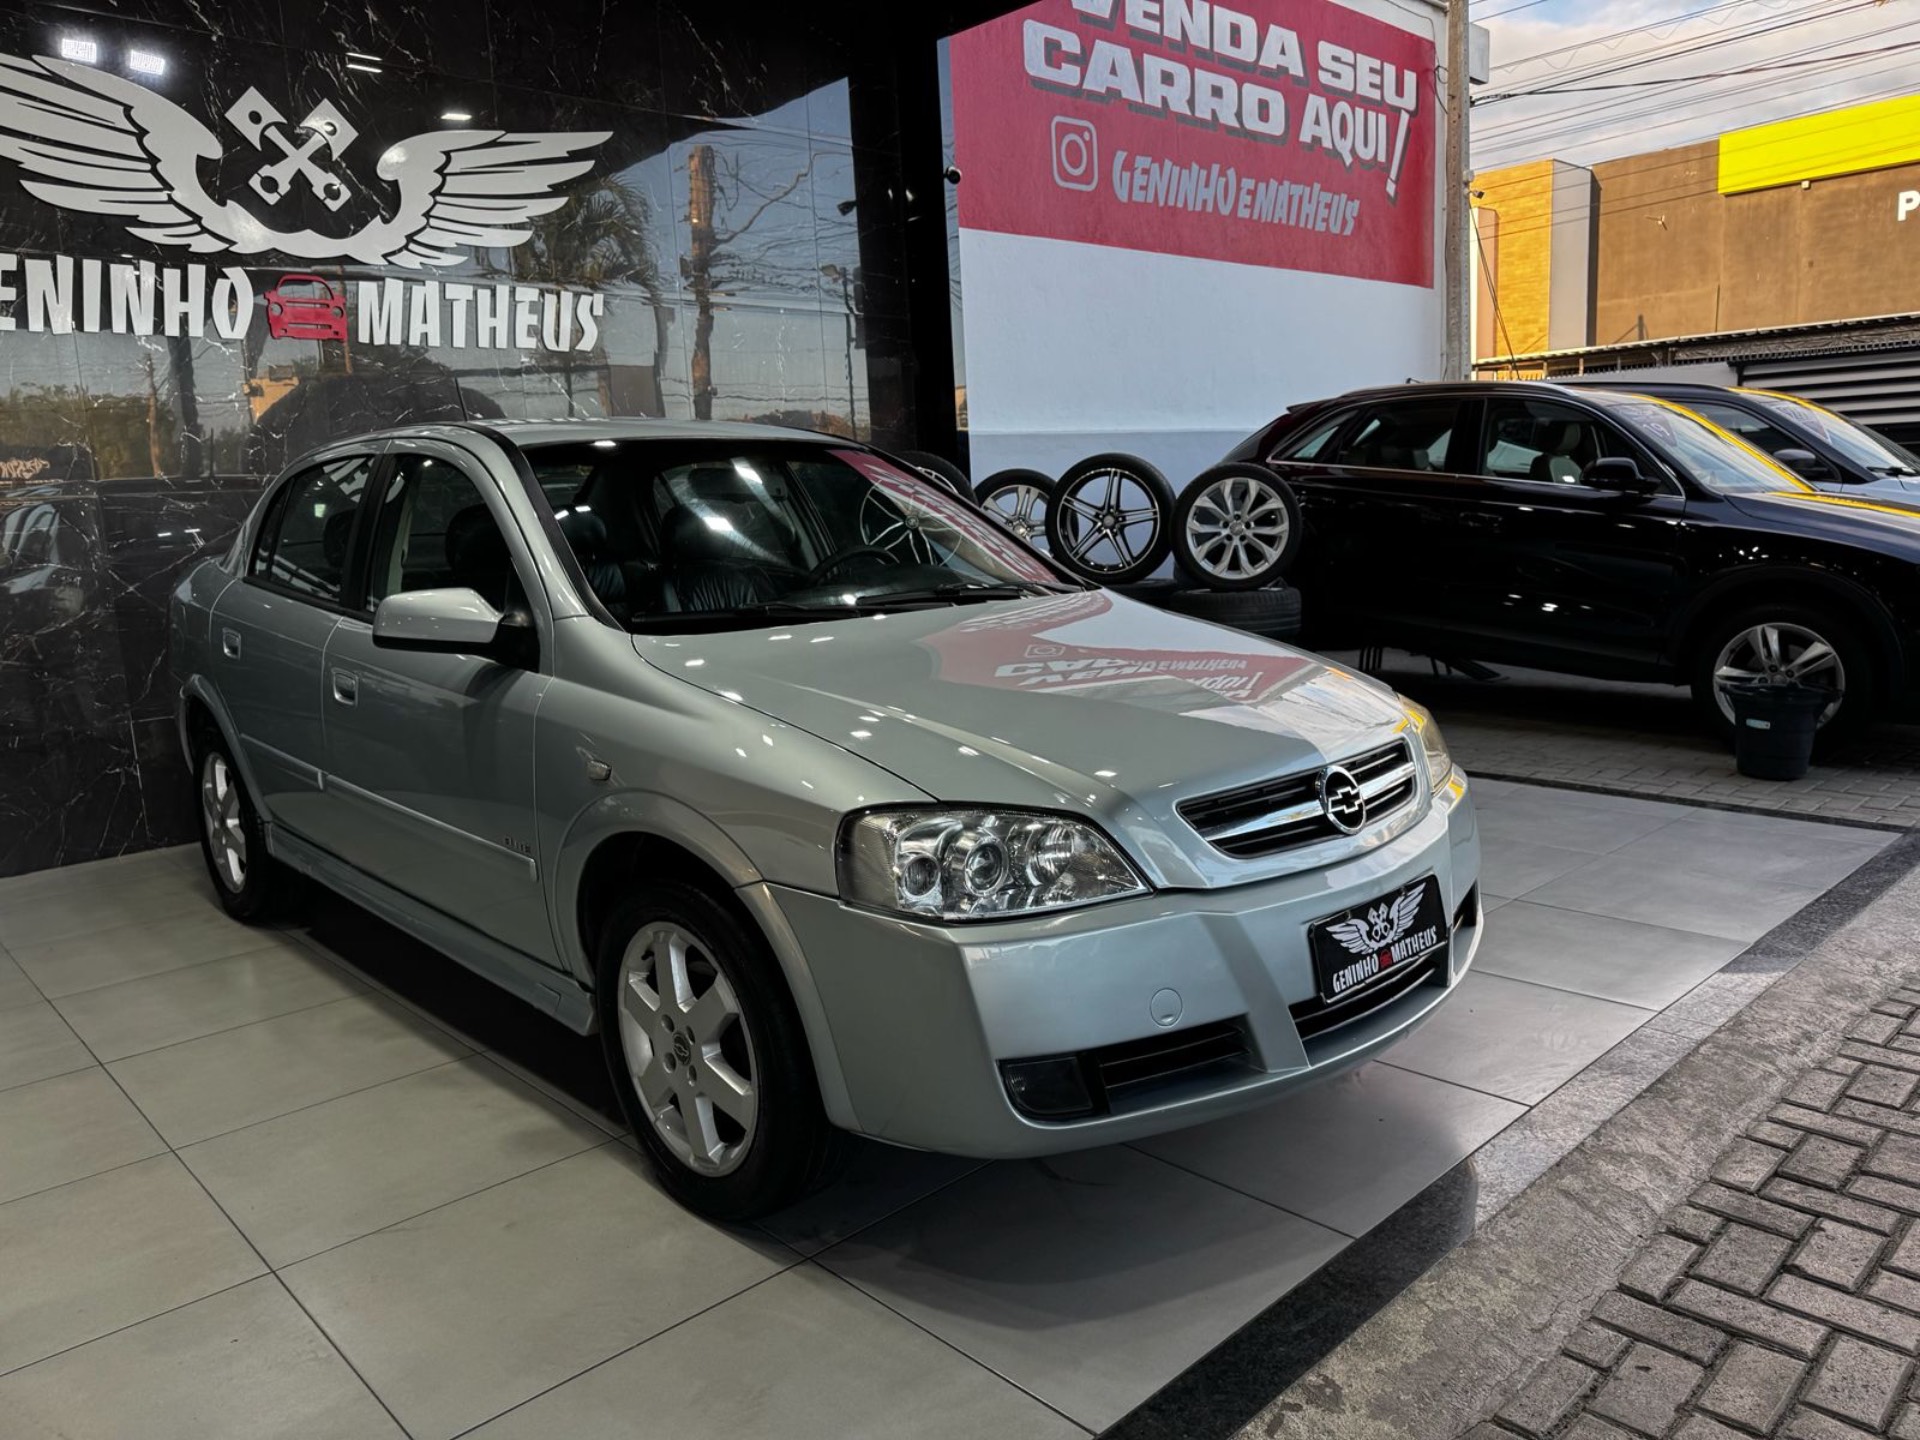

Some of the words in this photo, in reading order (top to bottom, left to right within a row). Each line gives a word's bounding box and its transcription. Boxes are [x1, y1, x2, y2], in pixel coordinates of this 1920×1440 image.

[1022, 17, 1286, 137] CARRO
[1299, 92, 1411, 199] AQUI!
[1317, 39, 1418, 112] SEU
[356, 276, 604, 353] MATHEUS
[1332, 951, 1380, 994] GENINHO
[1389, 924, 1438, 964] MATHEUS
